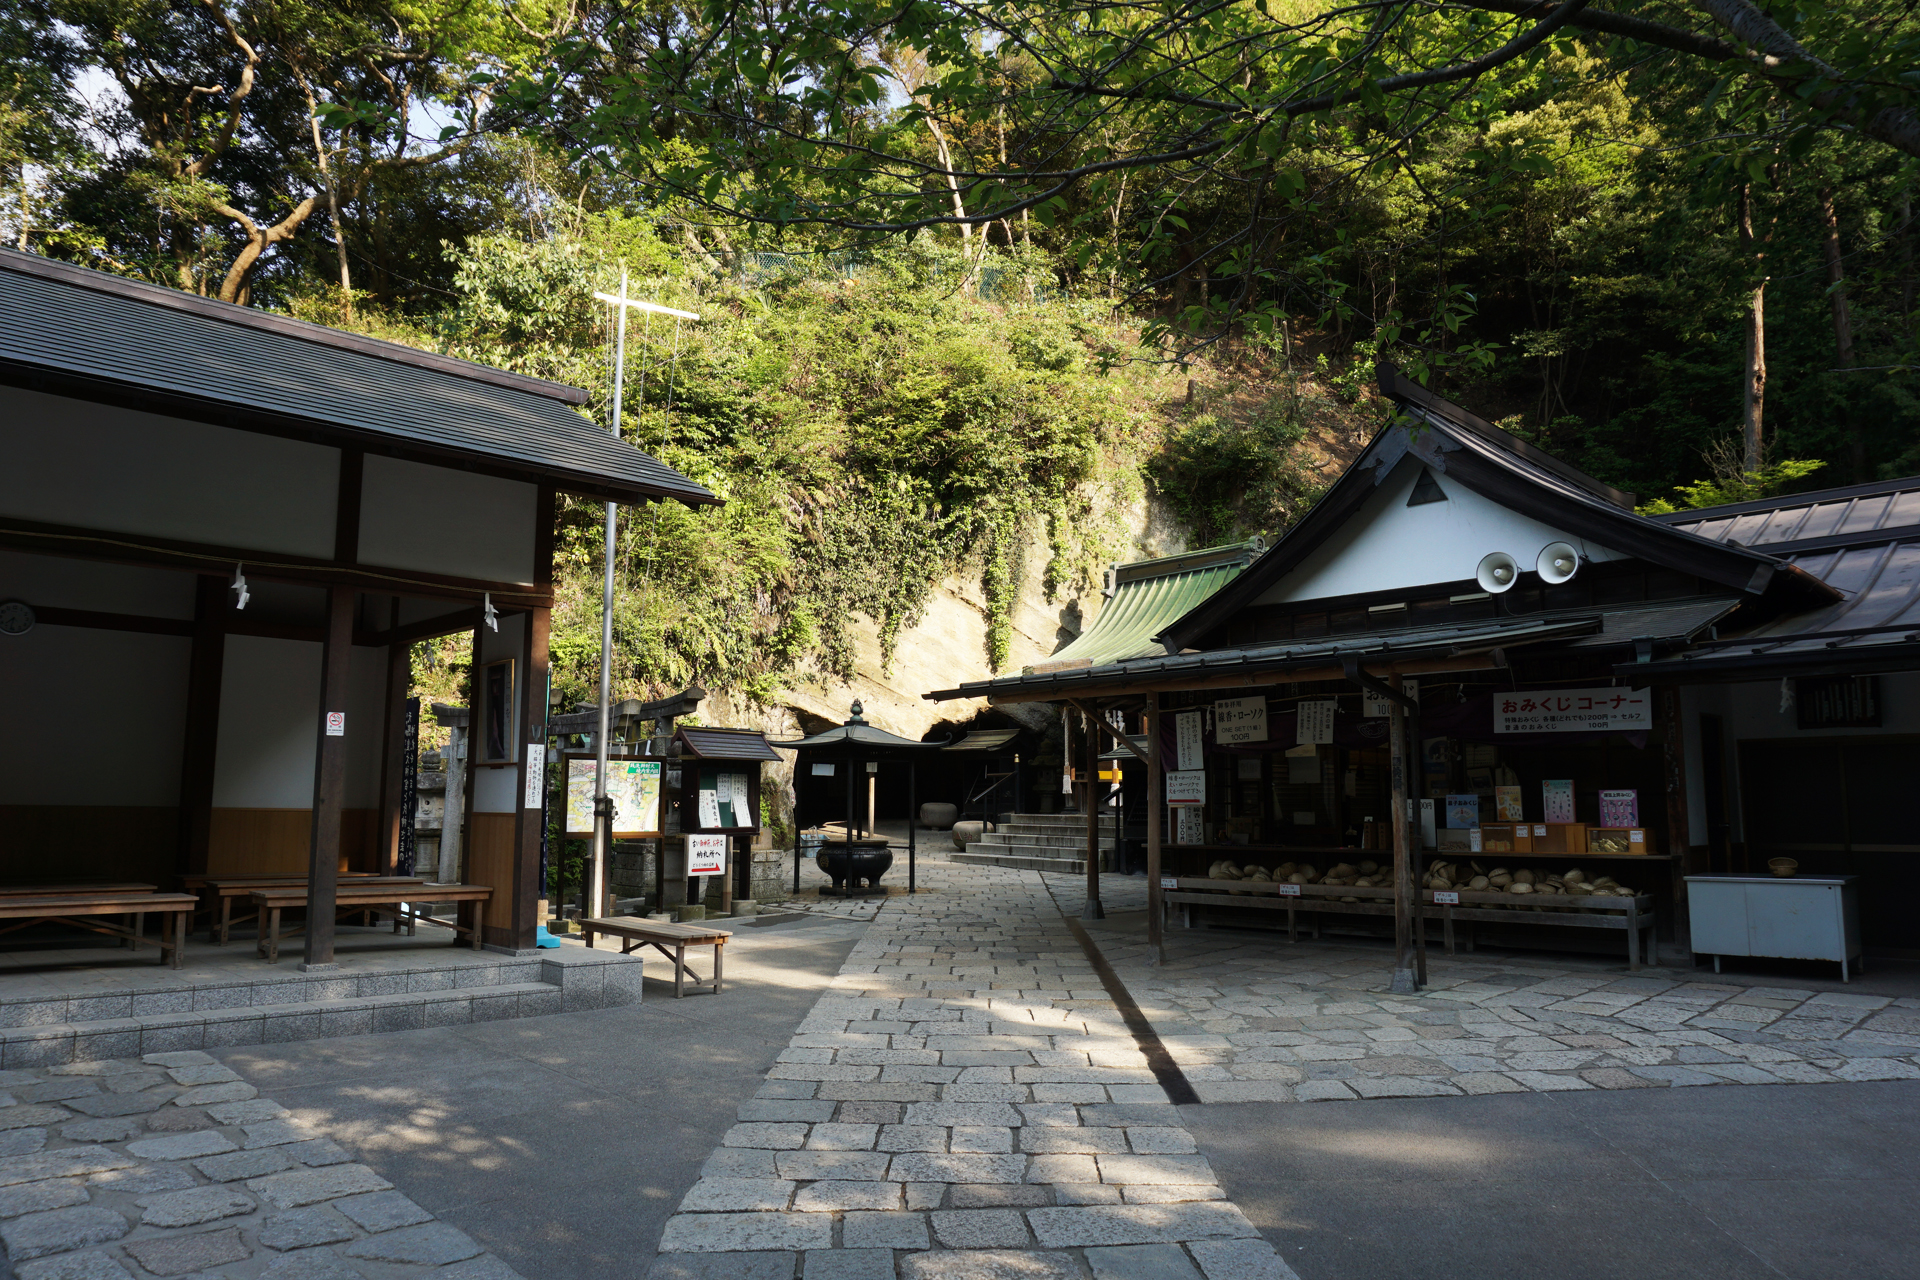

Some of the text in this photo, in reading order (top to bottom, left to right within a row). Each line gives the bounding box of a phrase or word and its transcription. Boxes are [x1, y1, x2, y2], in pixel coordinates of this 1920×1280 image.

[1502, 694, 1643, 714] おみくじ コーナー
[1218, 708, 1264, 723] 線香・ローソク
[1505, 723, 1557, 731] 普通のおみくじ
[1230, 733, 1250, 741] 100円
[1193, 806, 1202, 844] 線香・ローソク
[696, 850, 721, 859] 納札所へ
